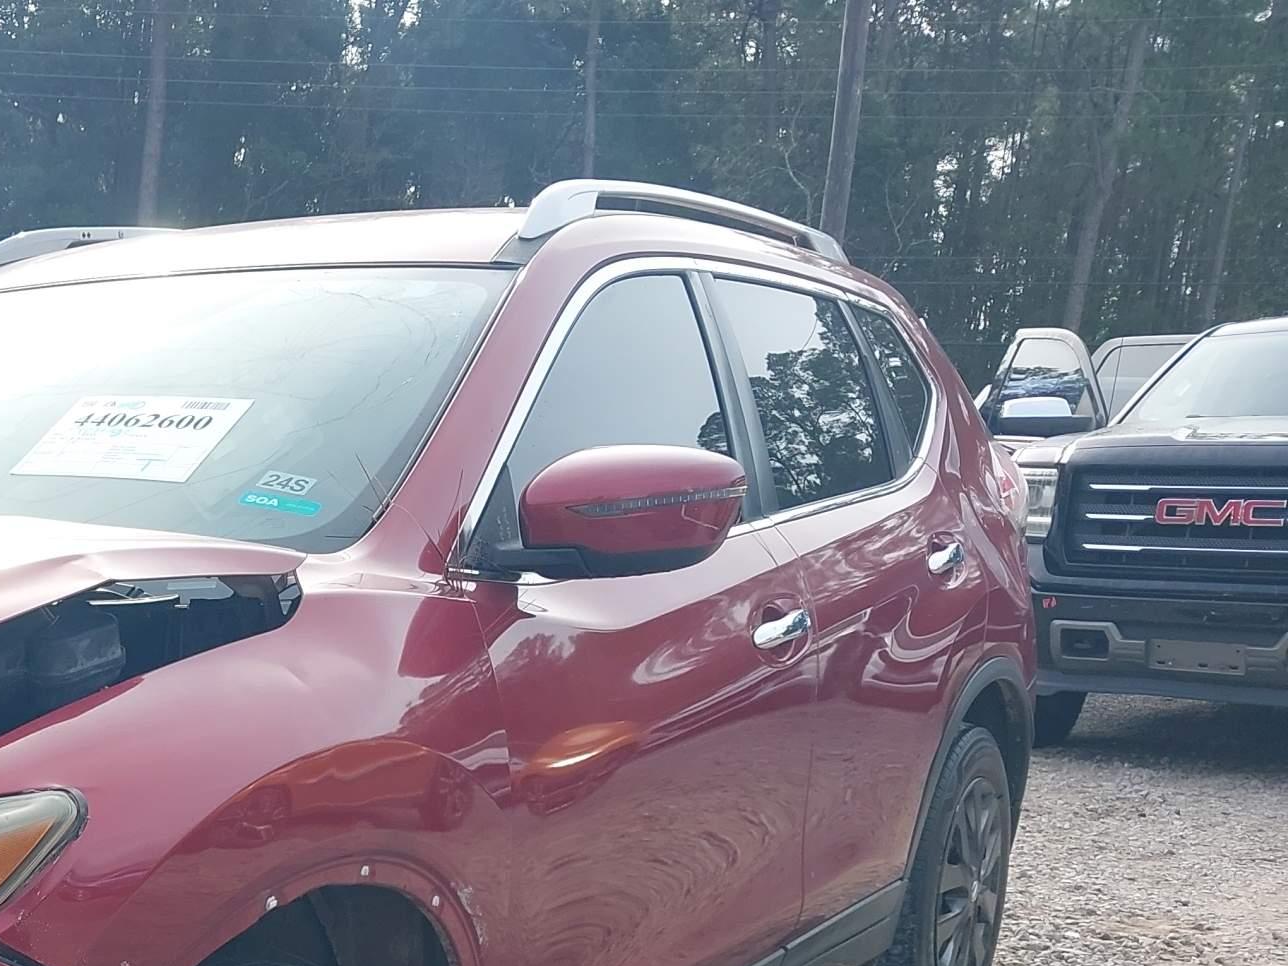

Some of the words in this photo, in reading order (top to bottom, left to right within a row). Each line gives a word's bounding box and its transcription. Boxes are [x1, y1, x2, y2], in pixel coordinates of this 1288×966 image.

[74, 412, 214, 430] 44062600
[261, 474, 309, 492] 24S
[1154, 498, 1287, 527] GMC
